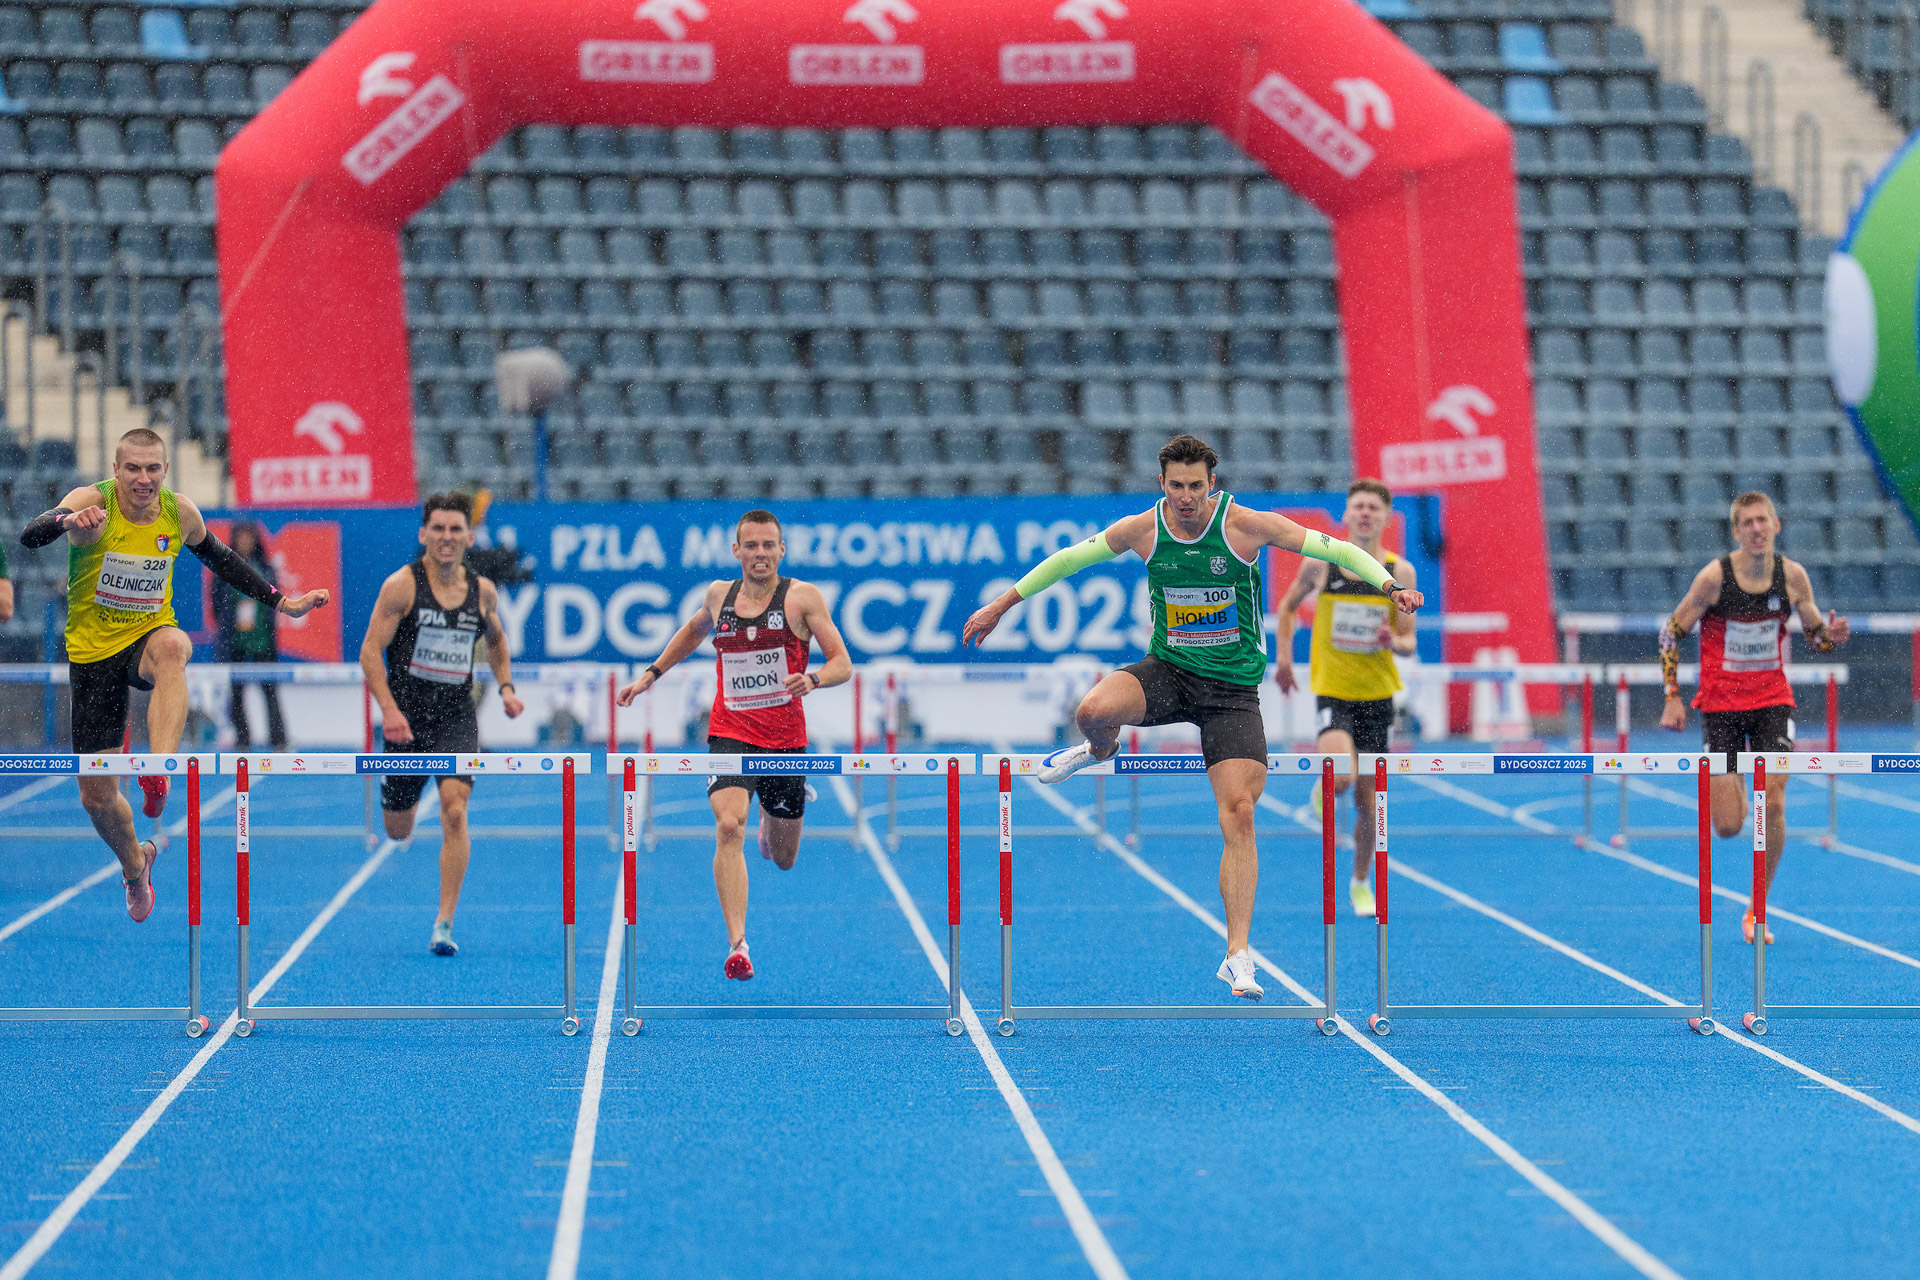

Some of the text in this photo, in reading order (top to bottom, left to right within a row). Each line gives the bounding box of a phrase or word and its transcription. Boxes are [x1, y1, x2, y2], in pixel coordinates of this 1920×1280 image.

[551, 524, 665, 571] PZLA
[681, 522, 1004, 568] MIRZOSTWA
[143, 560, 167, 571] 328
[101, 573, 164, 592] OLEJNICZAK
[1203, 590, 1229, 603] 100
[102, 599, 140, 610] BYDGOSZCZ
[497, 579, 954, 658] YDGCZ
[1175, 611, 1228, 626] HOŁUB
[755, 652, 779, 665] 309
[732, 670, 778, 690] KIDOŃ
[732, 699, 769, 709] BYDGOSZCZ
[49, 759, 73, 769] 2025
[361, 759, 424, 770] BYDGOSZCZ
[425, 759, 450, 770] 2025
[748, 760, 835, 770] BYDGOSZCZ 2025
[1121, 759, 1208, 770] BYDGOSZCZ 2025
[1500, 759, 1587, 770] BYDGOSZCZ 2025
[1878, 759, 1920, 769] BYDGOS
[239, 806, 248, 837] polanik
[626, 805, 634, 836] polanik
[1001, 806, 1010, 837] polanik
[1377, 806, 1386, 836] polanik
[1756, 805, 1764, 836] polanik
